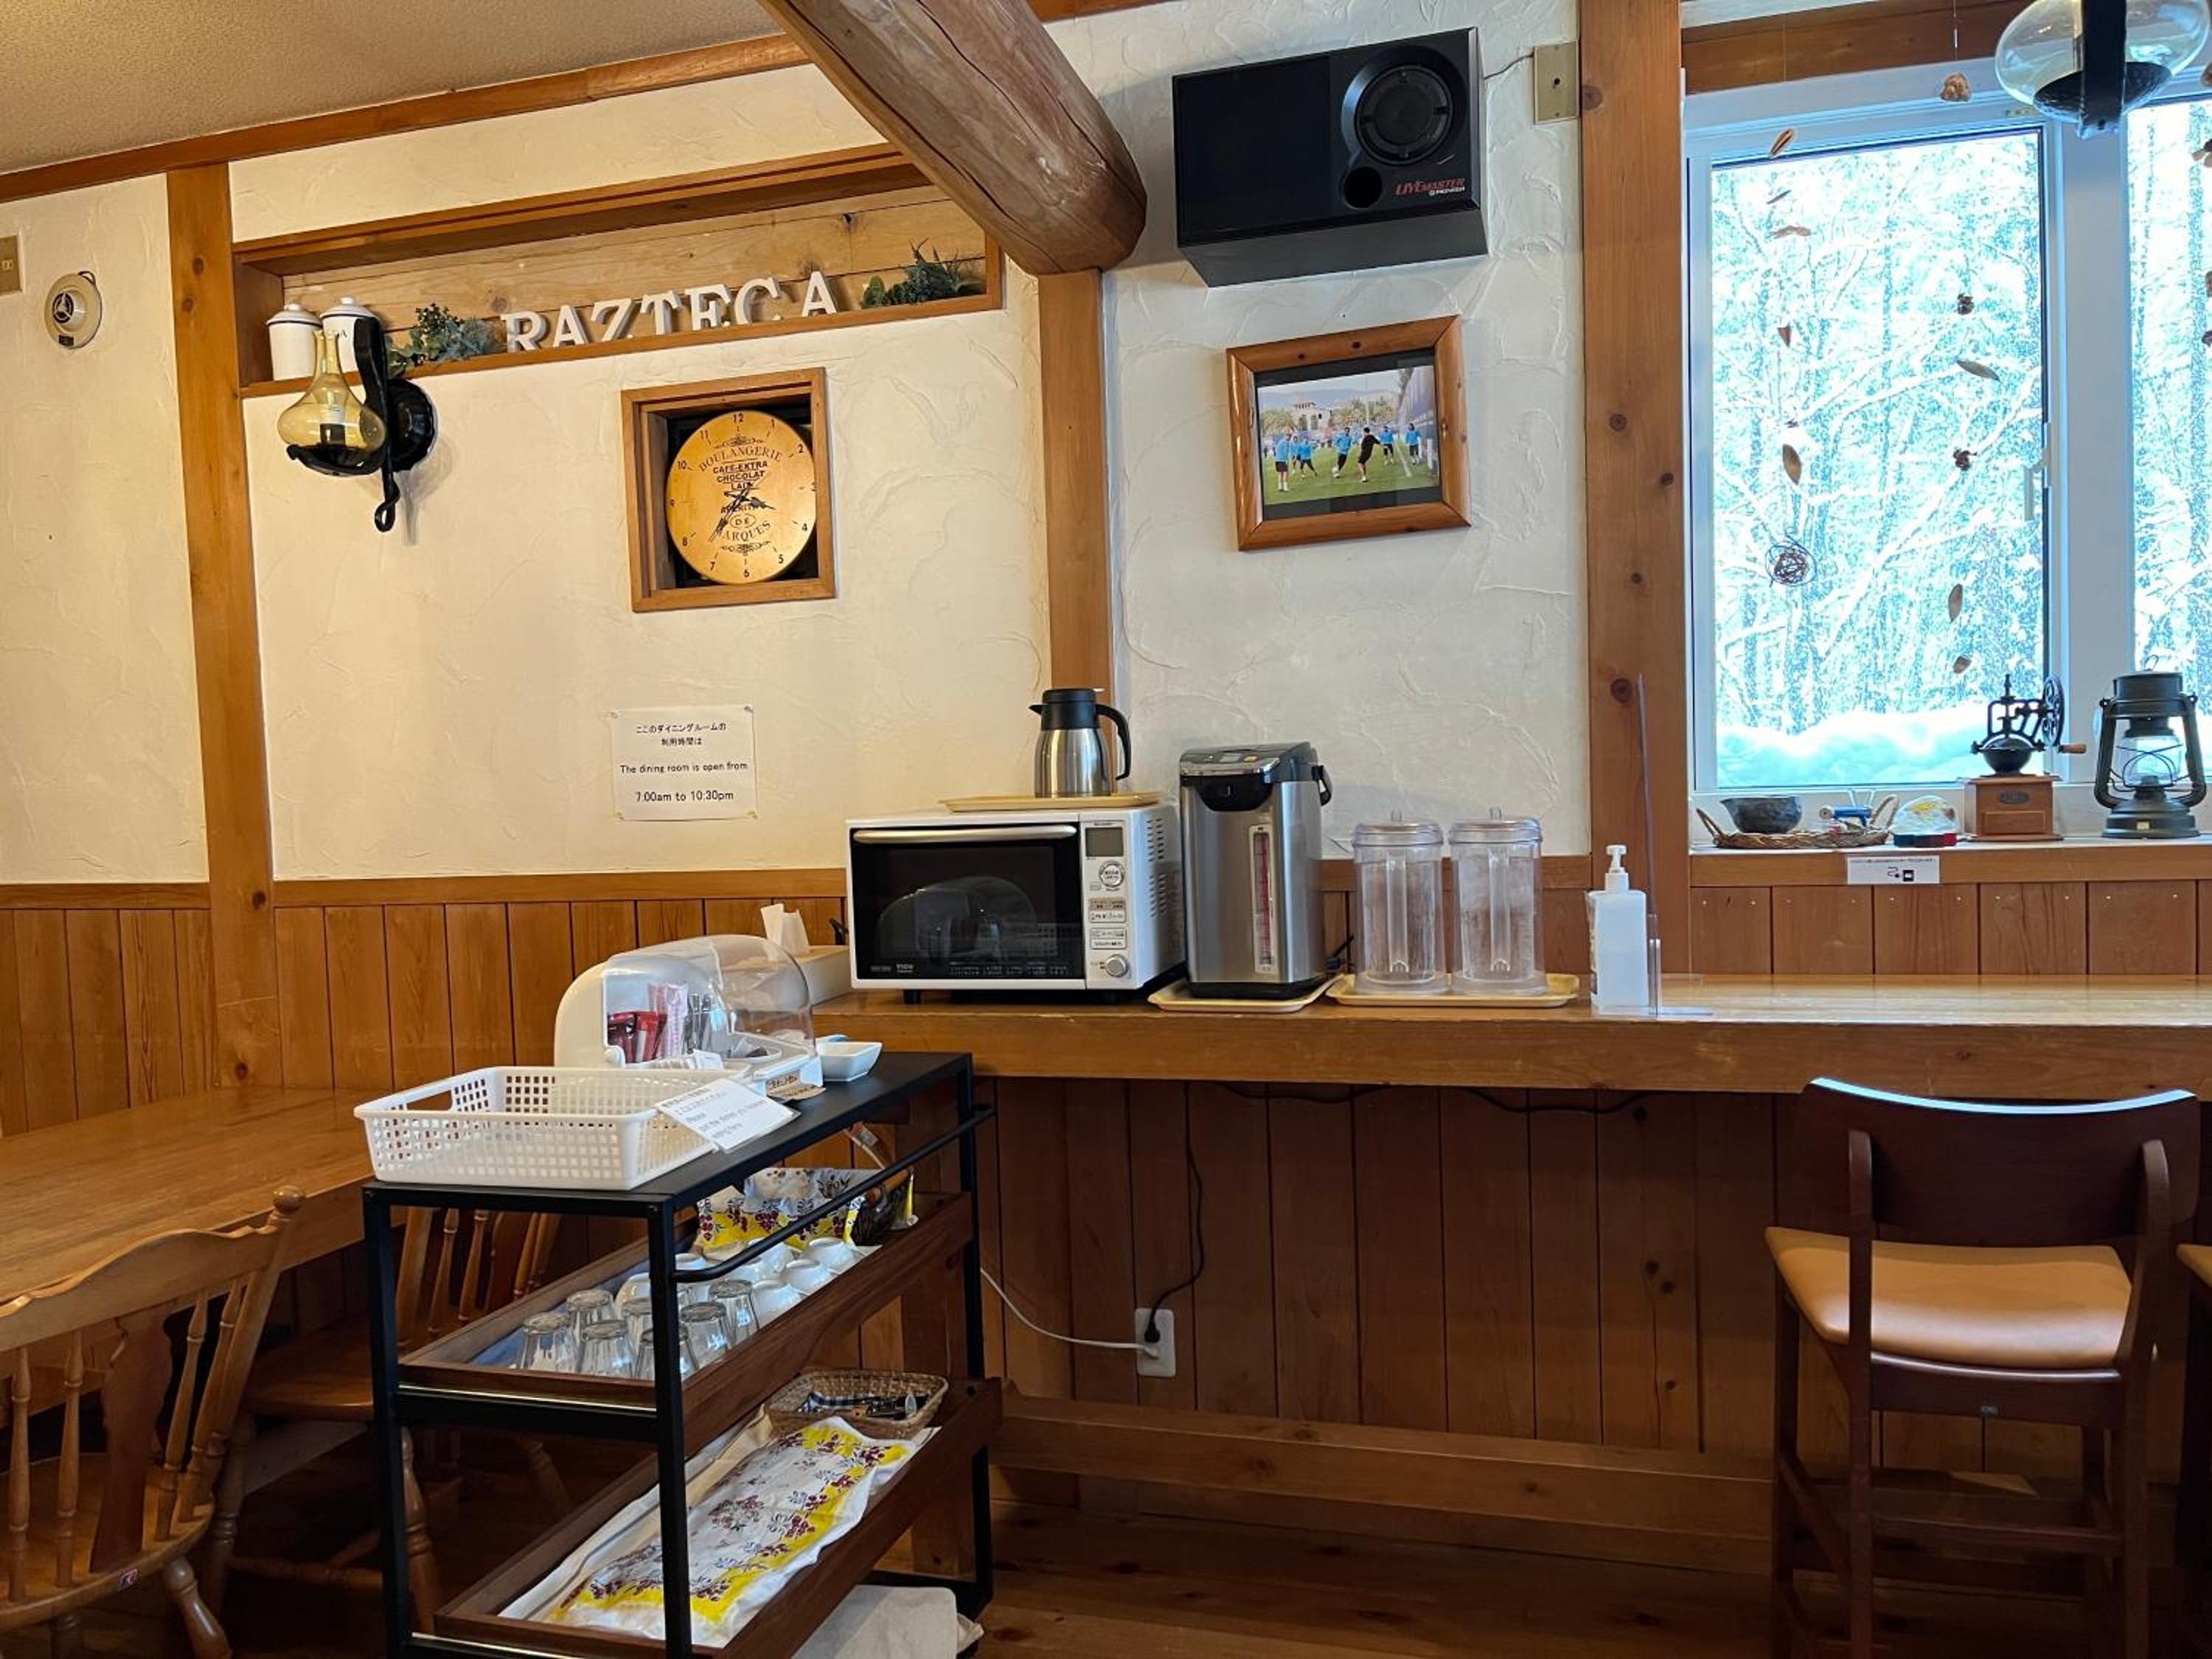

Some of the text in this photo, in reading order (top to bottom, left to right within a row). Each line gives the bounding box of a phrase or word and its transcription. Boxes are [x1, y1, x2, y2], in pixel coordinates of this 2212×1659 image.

[733, 412, 744, 423] 12
[771, 419, 776, 428] 1
[700, 430, 709, 439] 11
[798, 444, 804, 453] 2
[678, 460, 687, 470] 10
[717, 470, 766, 483] CHOCOLAT
[718, 520, 771, 542] ARQUES
[801, 523, 807, 532] 4
[682, 537, 688, 546] 8
[779, 554, 784, 564] 5
[710, 561, 716, 571] 7
[743, 568, 750, 578] 6
[636, 722, 726, 734] ここのダイニングルームの
[620, 765, 636, 773] The
[639, 763, 664, 774] dining
[692, 764, 700, 772] is
[703, 764, 724, 773] open
[727, 761, 748, 771] from
[675, 792, 686, 801] to
[691, 790, 734, 802] 10:30pm
